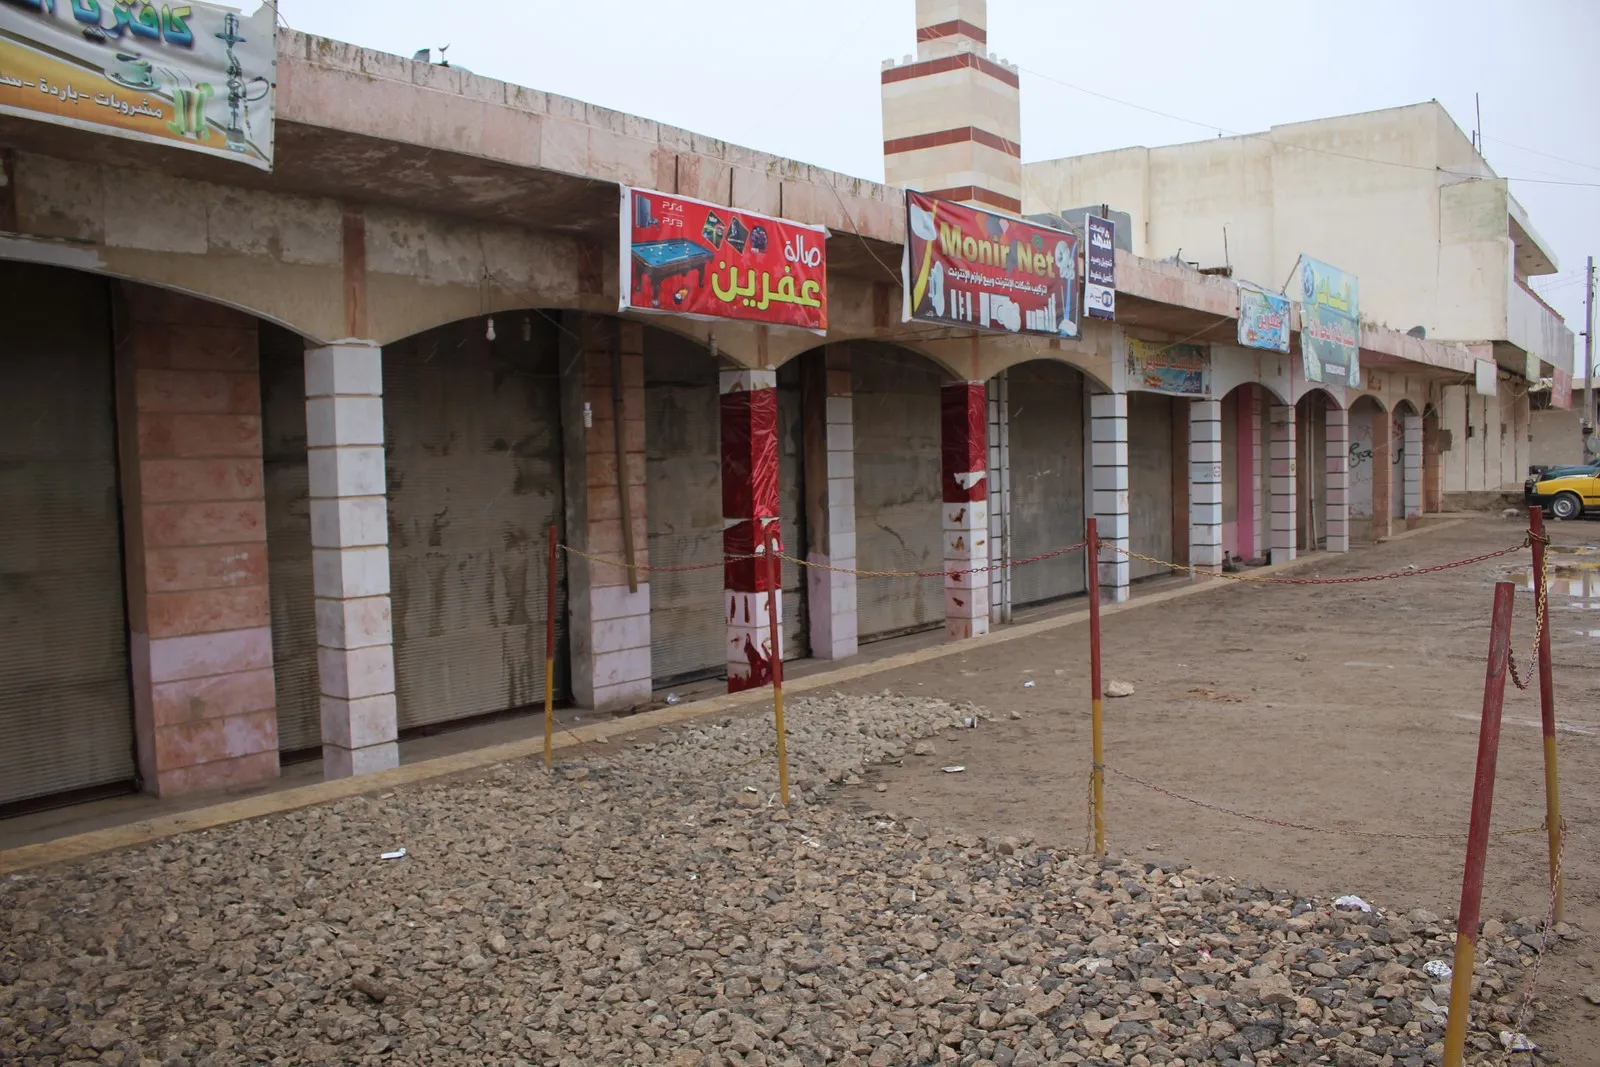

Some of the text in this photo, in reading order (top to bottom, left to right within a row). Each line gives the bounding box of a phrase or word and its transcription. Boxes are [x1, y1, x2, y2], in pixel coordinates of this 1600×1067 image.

[94, 92, 164, 119] مشروبات
[662, 201, 683, 212] PS4
[662, 216, 683, 228] PS3
[784, 234, 822, 268] صالة
[940, 221, 1056, 278] Monir Net
[711, 261, 822, 311] عفرين
[1014, 280, 1031, 292] شبكات
